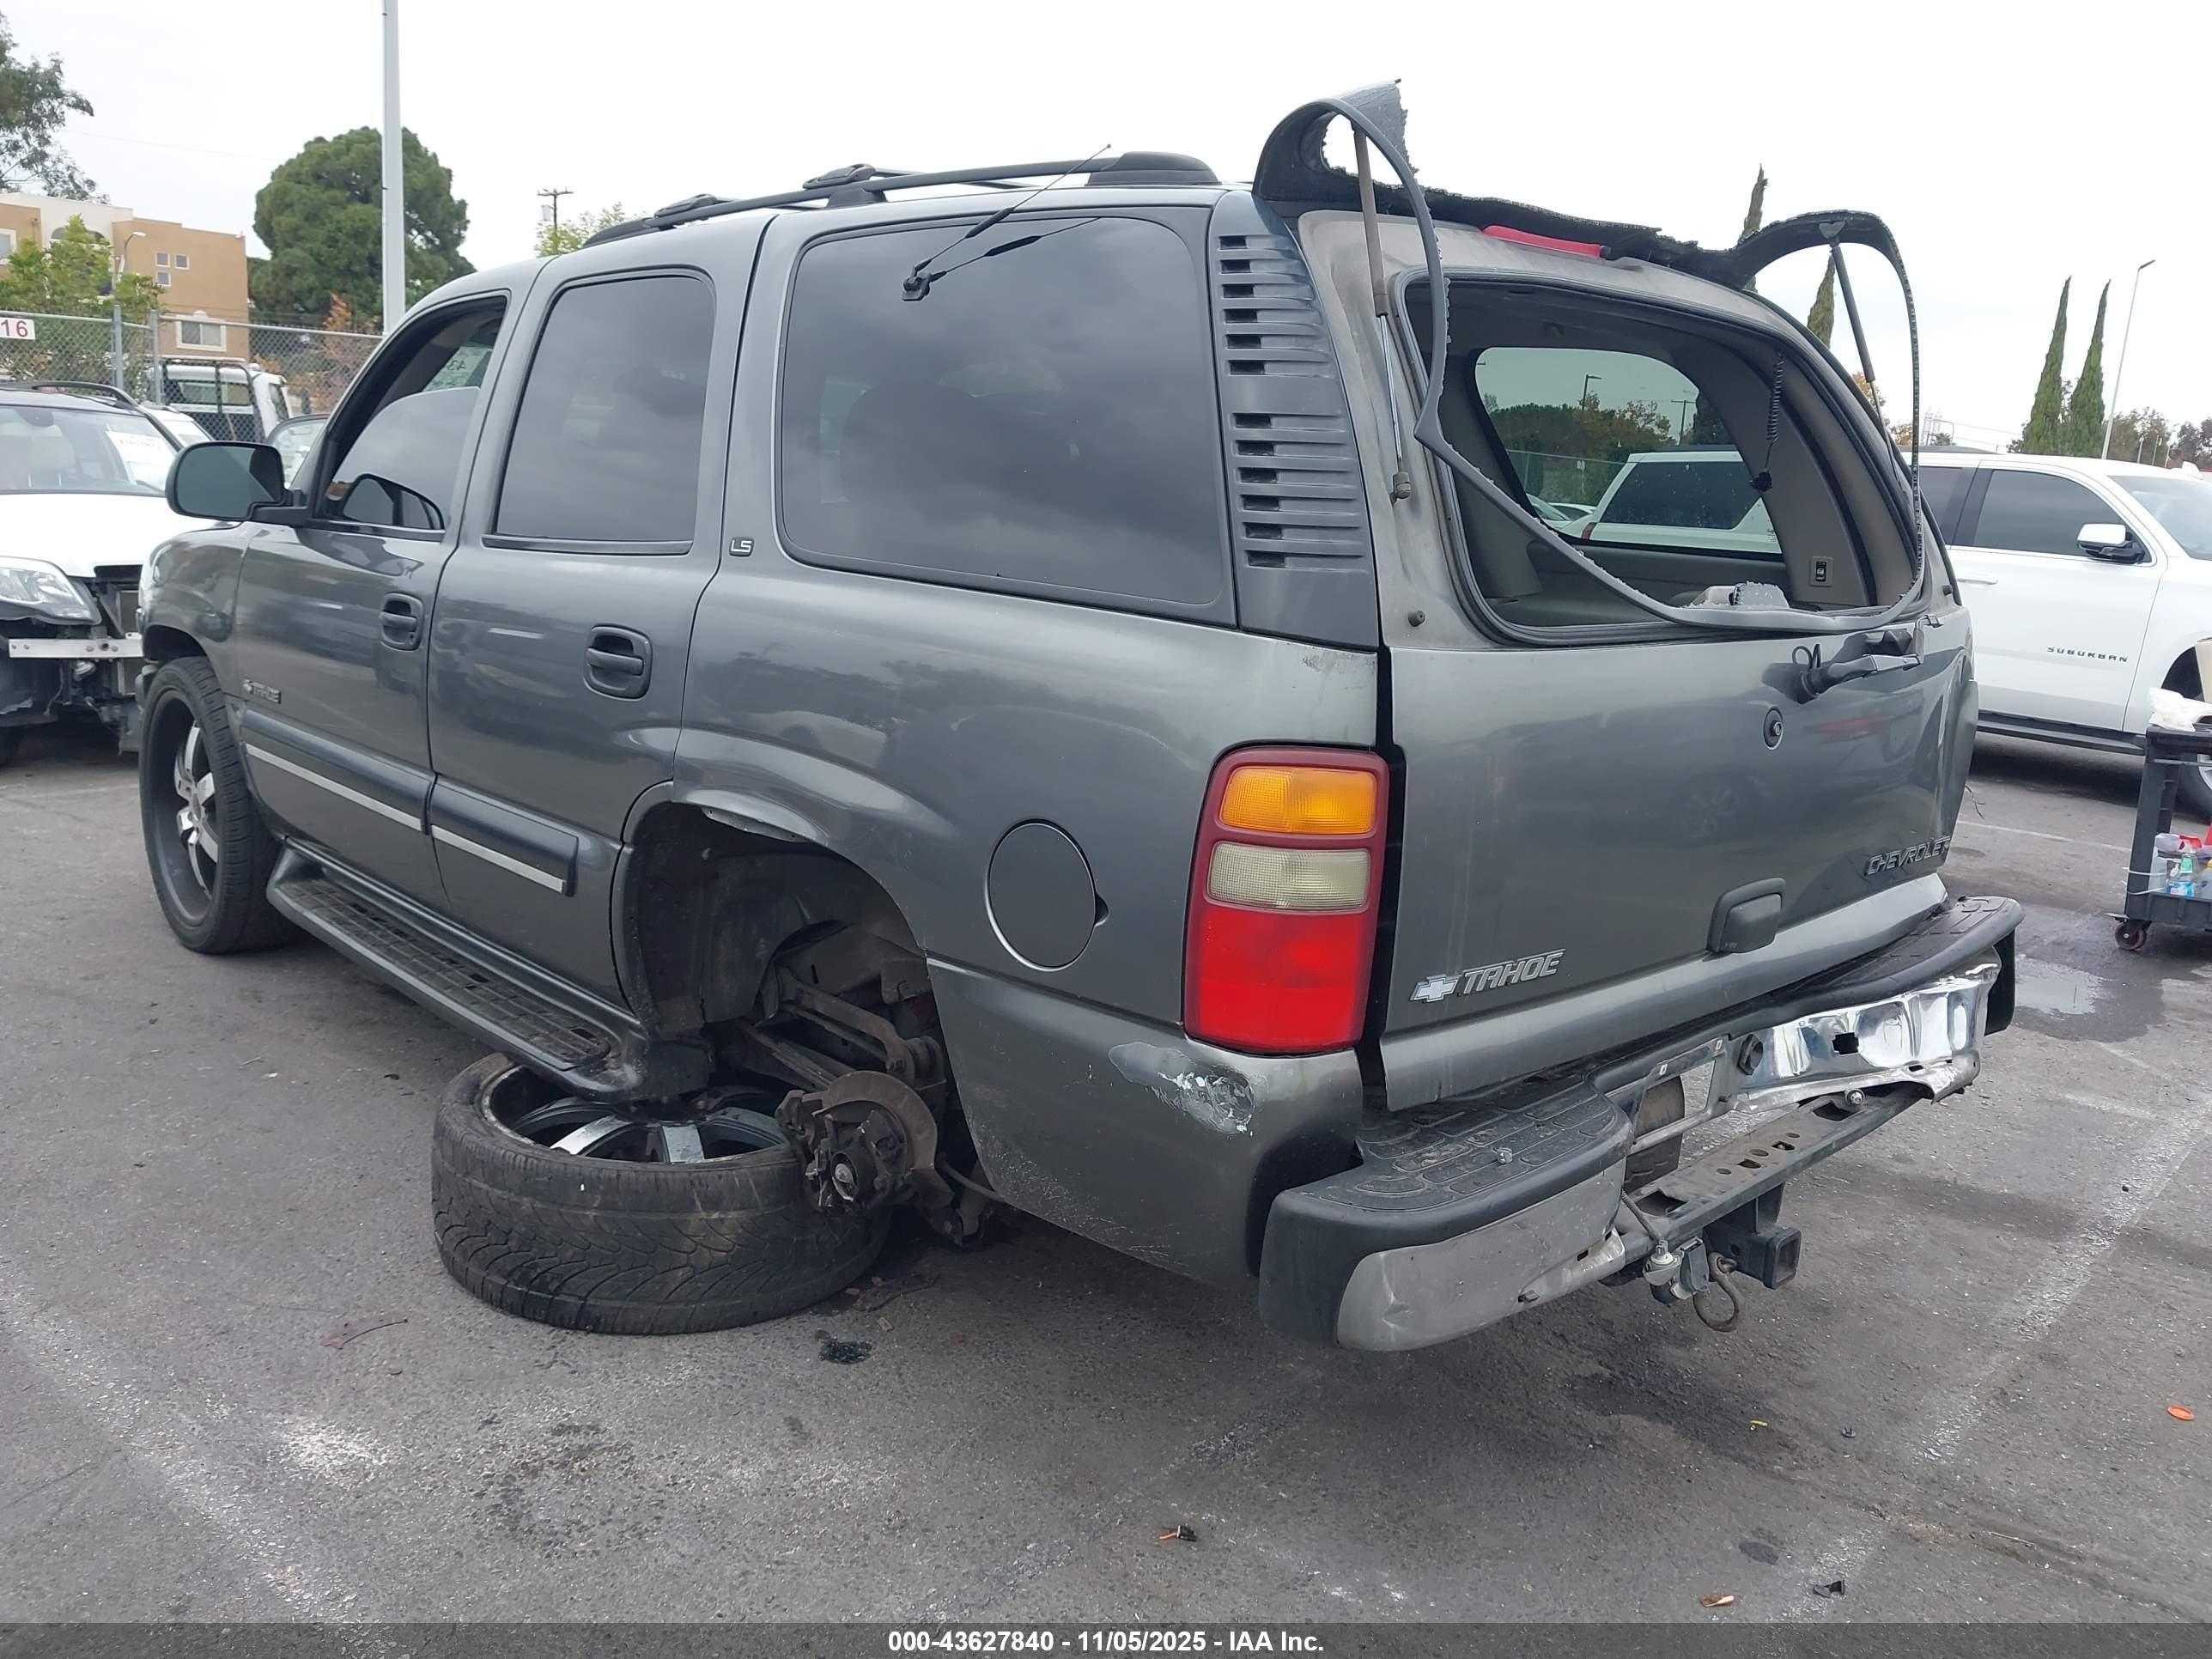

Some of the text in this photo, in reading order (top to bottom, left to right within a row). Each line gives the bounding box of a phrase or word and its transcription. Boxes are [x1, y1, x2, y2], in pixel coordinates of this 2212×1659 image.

[1, 319, 28, 337] 16
[731, 540, 752, 553] LS
[2047, 647, 2128, 663] SUBURBAN
[1462, 949, 1566, 995] TAHOE
